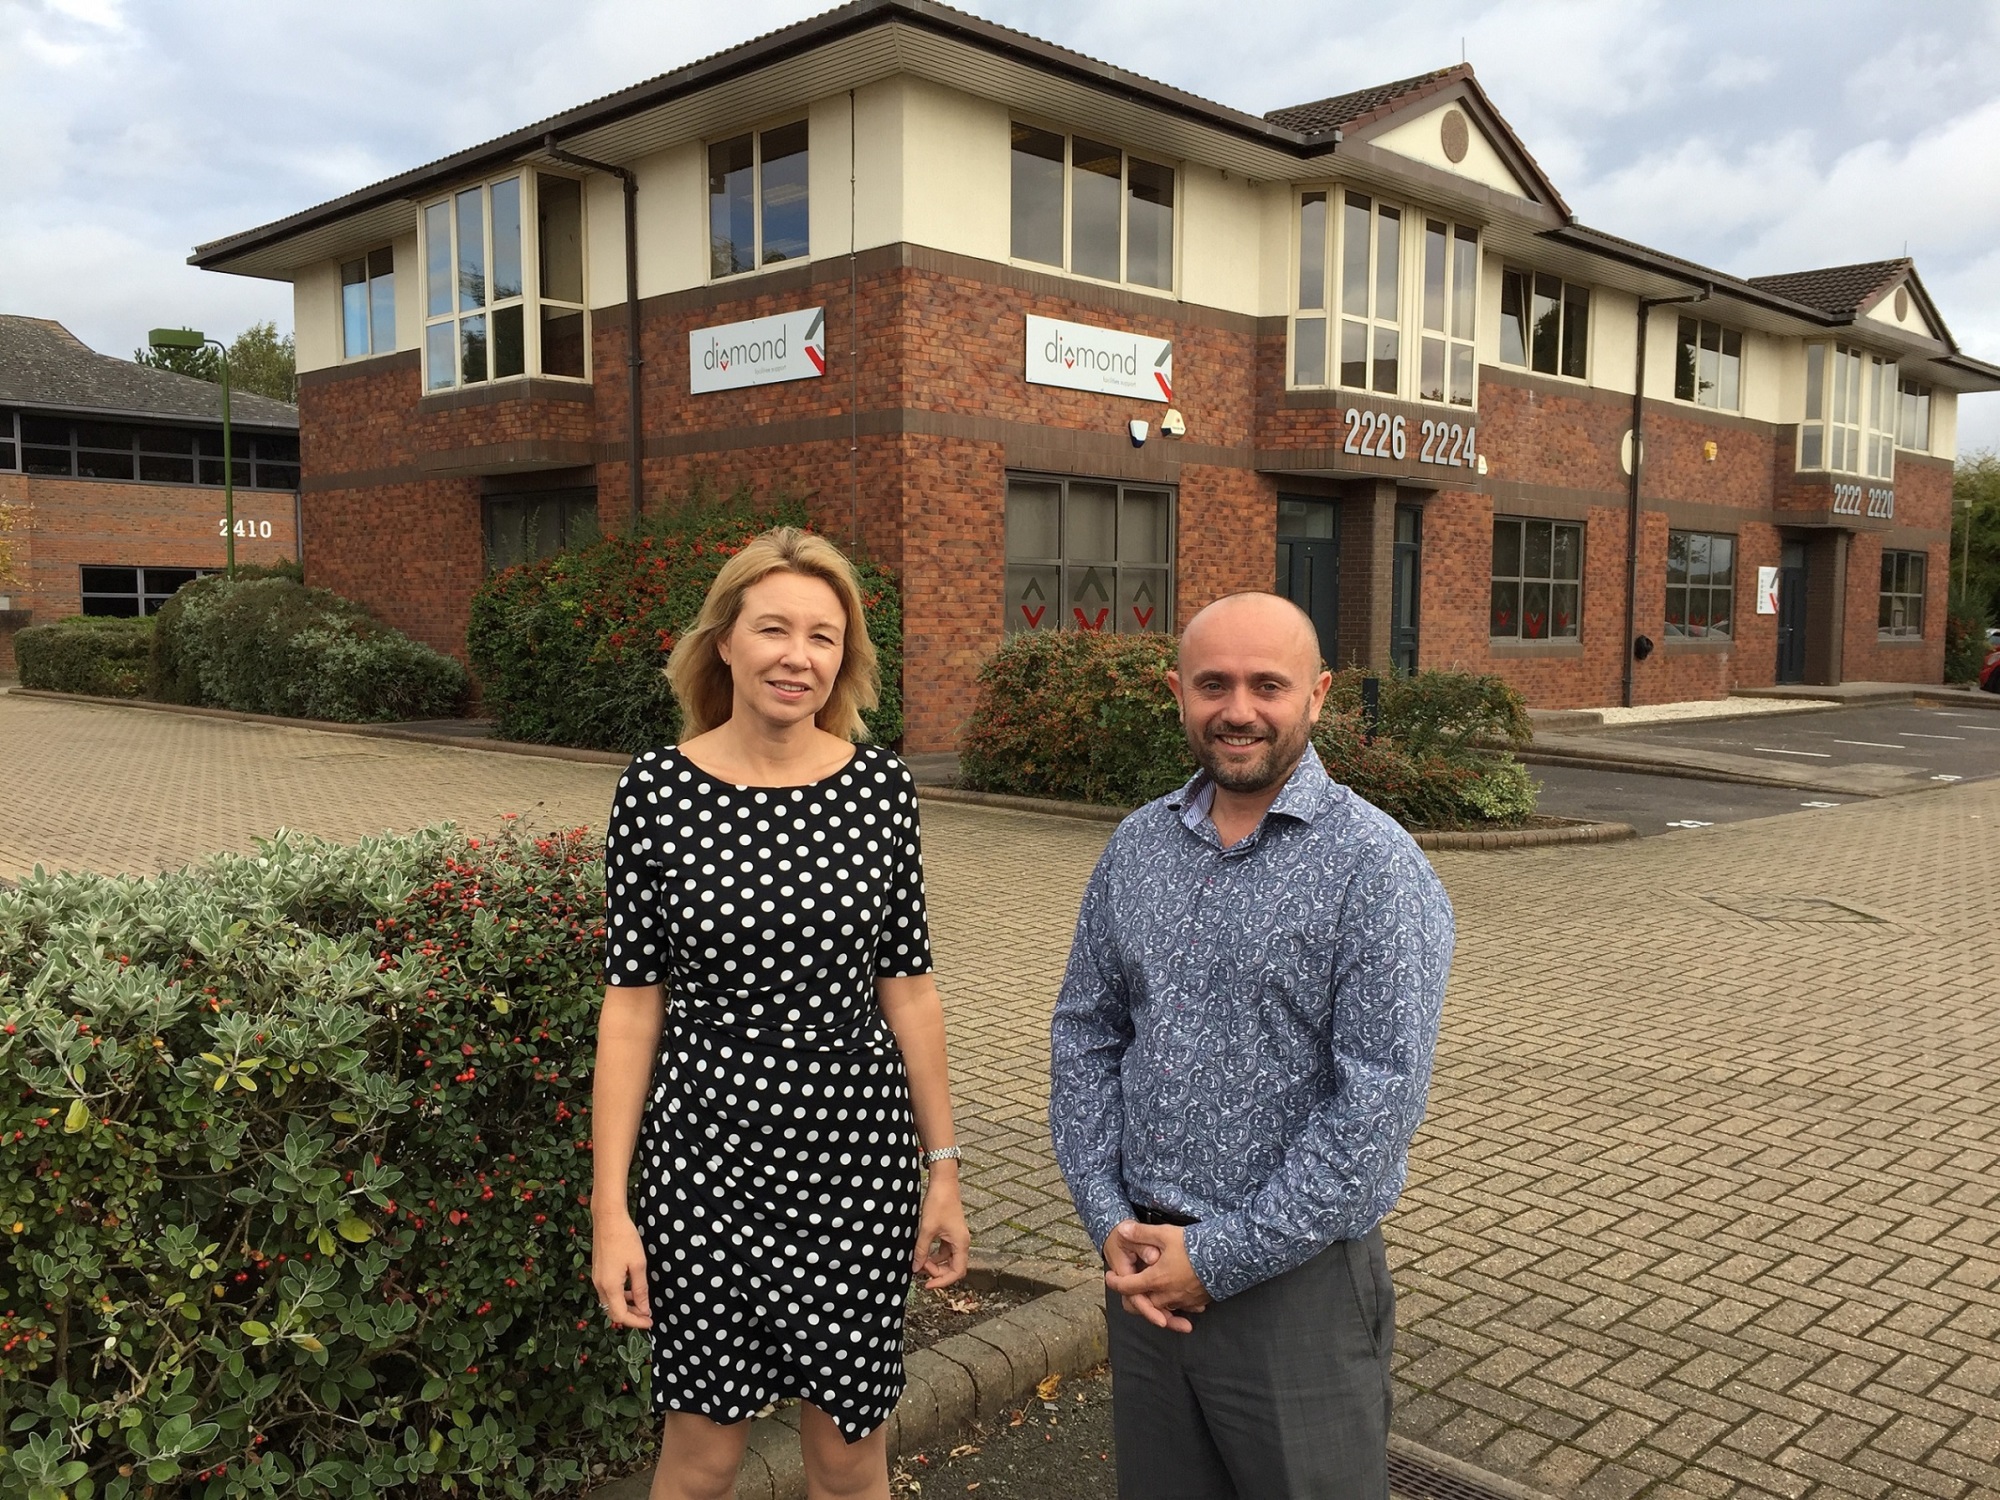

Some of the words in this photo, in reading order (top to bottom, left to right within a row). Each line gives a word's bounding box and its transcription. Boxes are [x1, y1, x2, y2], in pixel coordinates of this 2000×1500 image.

[1344, 408, 1406, 460] 2226
[1420, 419, 1477, 468] 2224
[1833, 483, 1862, 516] 2222
[1867, 487, 1894, 519] 2220
[218, 518, 273, 539] 2410
